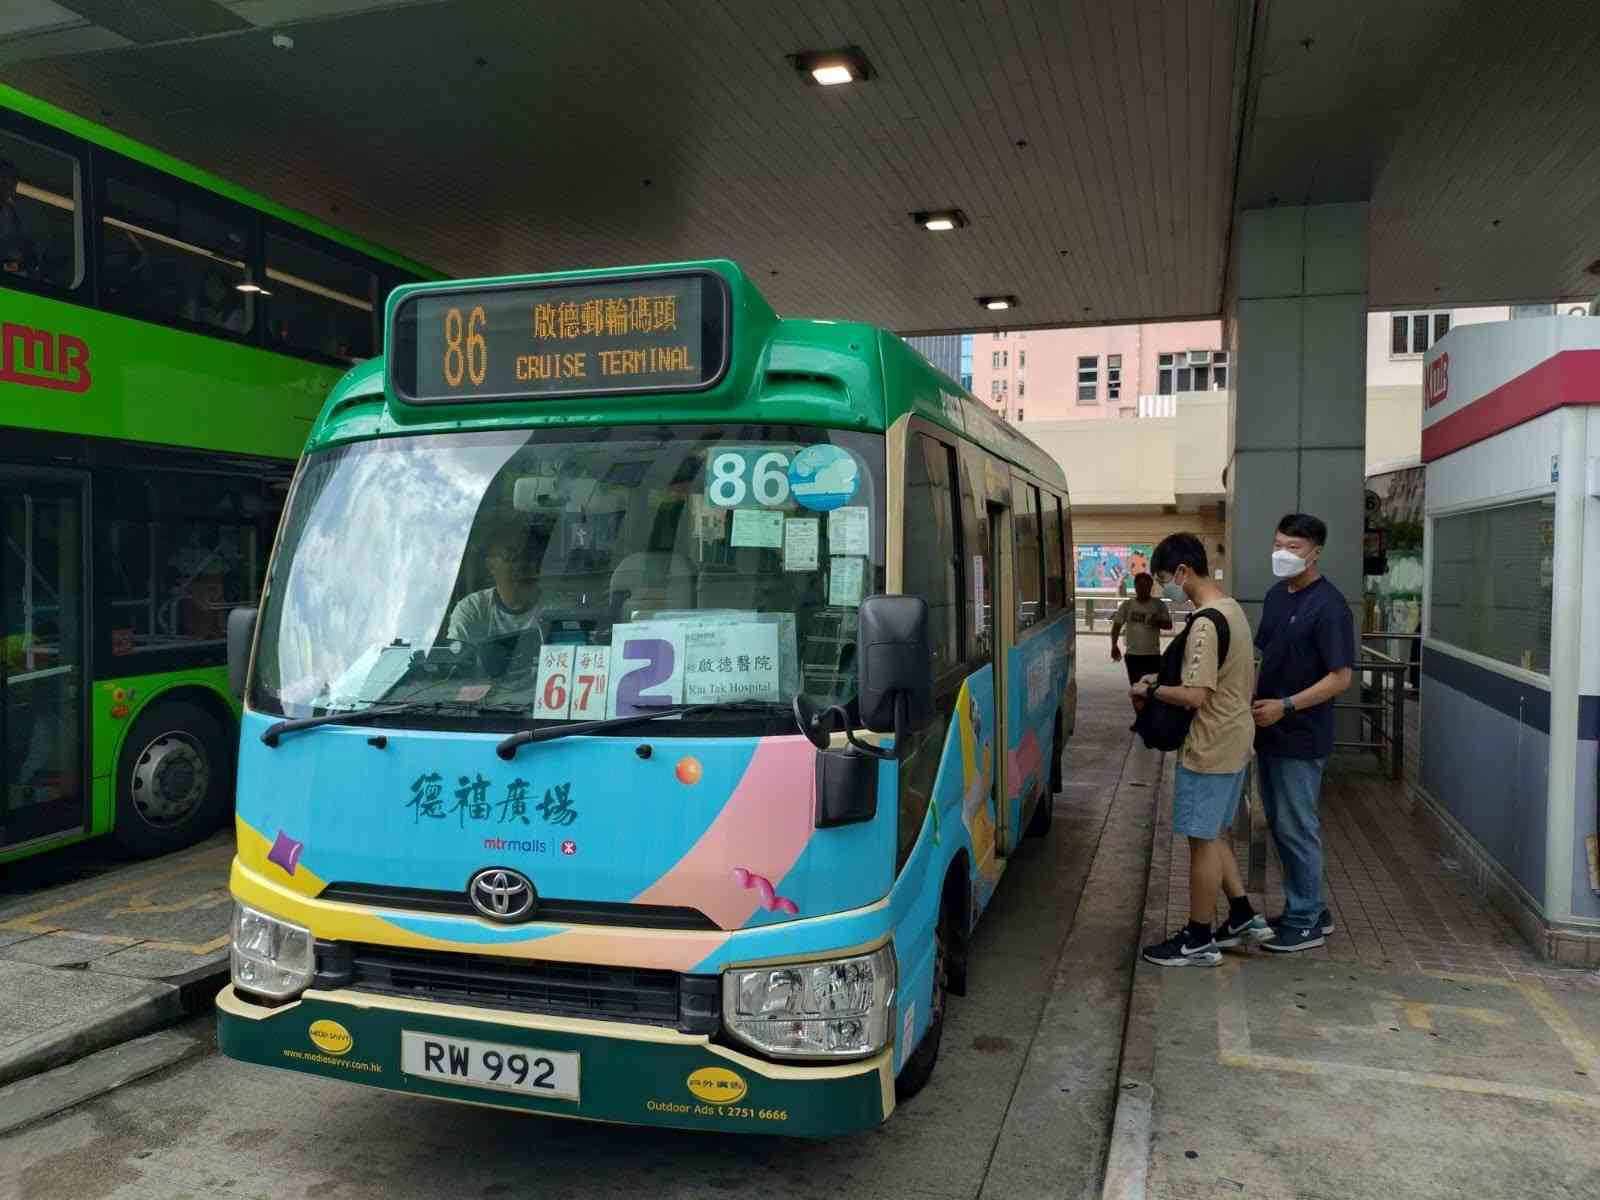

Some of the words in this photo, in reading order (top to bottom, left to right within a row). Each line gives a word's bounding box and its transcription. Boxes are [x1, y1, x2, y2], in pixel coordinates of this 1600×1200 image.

[0, 320, 92, 393] MB
[444, 306, 488, 386] 86
[515, 352, 587, 380] CRUISE
[598, 345, 695, 376] TERMINAL
[1424, 351, 1448, 412] KMB
[710, 452, 789, 506] 86
[616, 639, 676, 717] 2
[730, 681, 770, 694] Hospital
[405, 772, 578, 829] 德福廣場
[484, 836, 546, 852] mtrmalls
[283, 1049, 382, 1073] www.mediasavvy.com.hk
[425, 1040, 469, 1078] RW
[482, 1049, 555, 1090] 992
[647, 1101, 689, 1113] Outdoor
[694, 1104, 714, 1115] Ads
[727, 1106, 754, 1118] 2751
[759, 1110, 788, 1121] 6666
